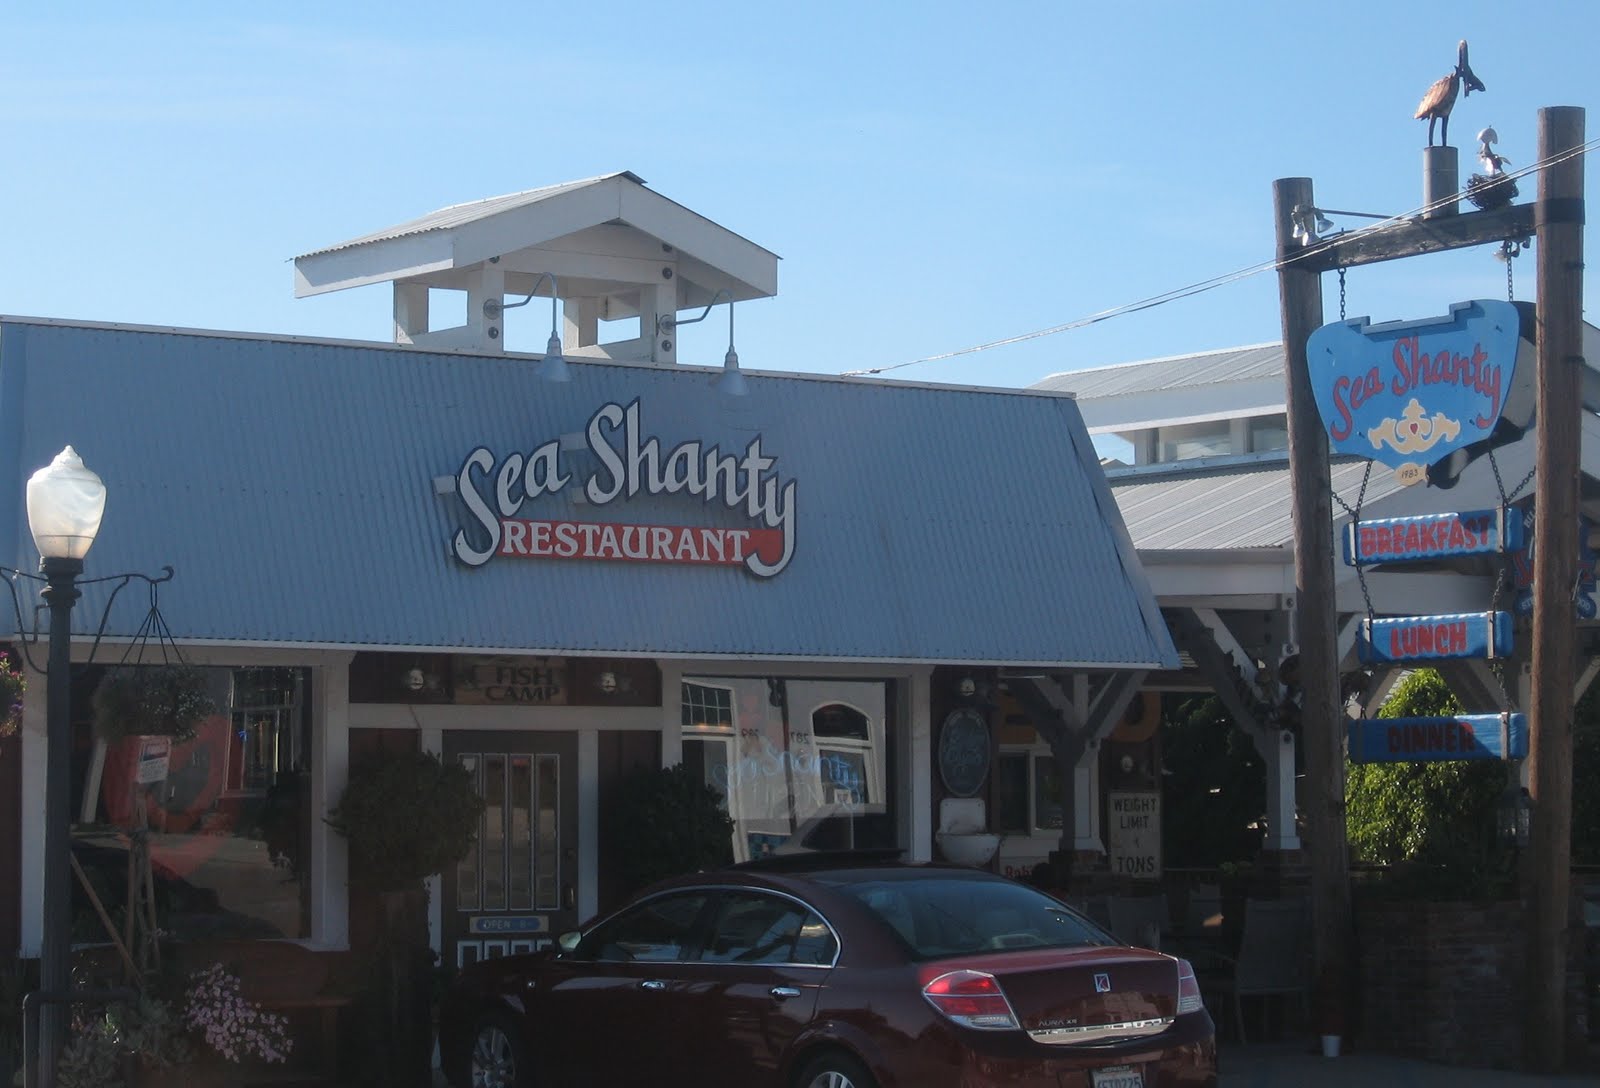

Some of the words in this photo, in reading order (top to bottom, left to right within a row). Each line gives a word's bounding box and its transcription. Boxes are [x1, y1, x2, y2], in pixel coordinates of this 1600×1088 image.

[1331, 367, 1385, 441] Sea
[1391, 335, 1501, 429] Shanty
[1400, 468, 1419, 479] 1983
[455, 441, 573, 566] Sea
[585, 396, 797, 578] Shanty
[502, 520, 750, 562] RESTAURANT
[1360, 516, 1490, 557] BREAKFAST
[1390, 621, 1467, 657] LUNCH
[496, 666, 553, 684] FISH
[486, 685, 561, 702] CAMP
[1386, 721, 1476, 752] DINNER
[1114, 798, 1157, 812] WEIGHT
[1120, 816, 1149, 829] LIMIT
[1117, 855, 1154, 873] TONS
[482, 919, 512, 930] OPEN
[1038, 1018, 1065, 1027] AURA
